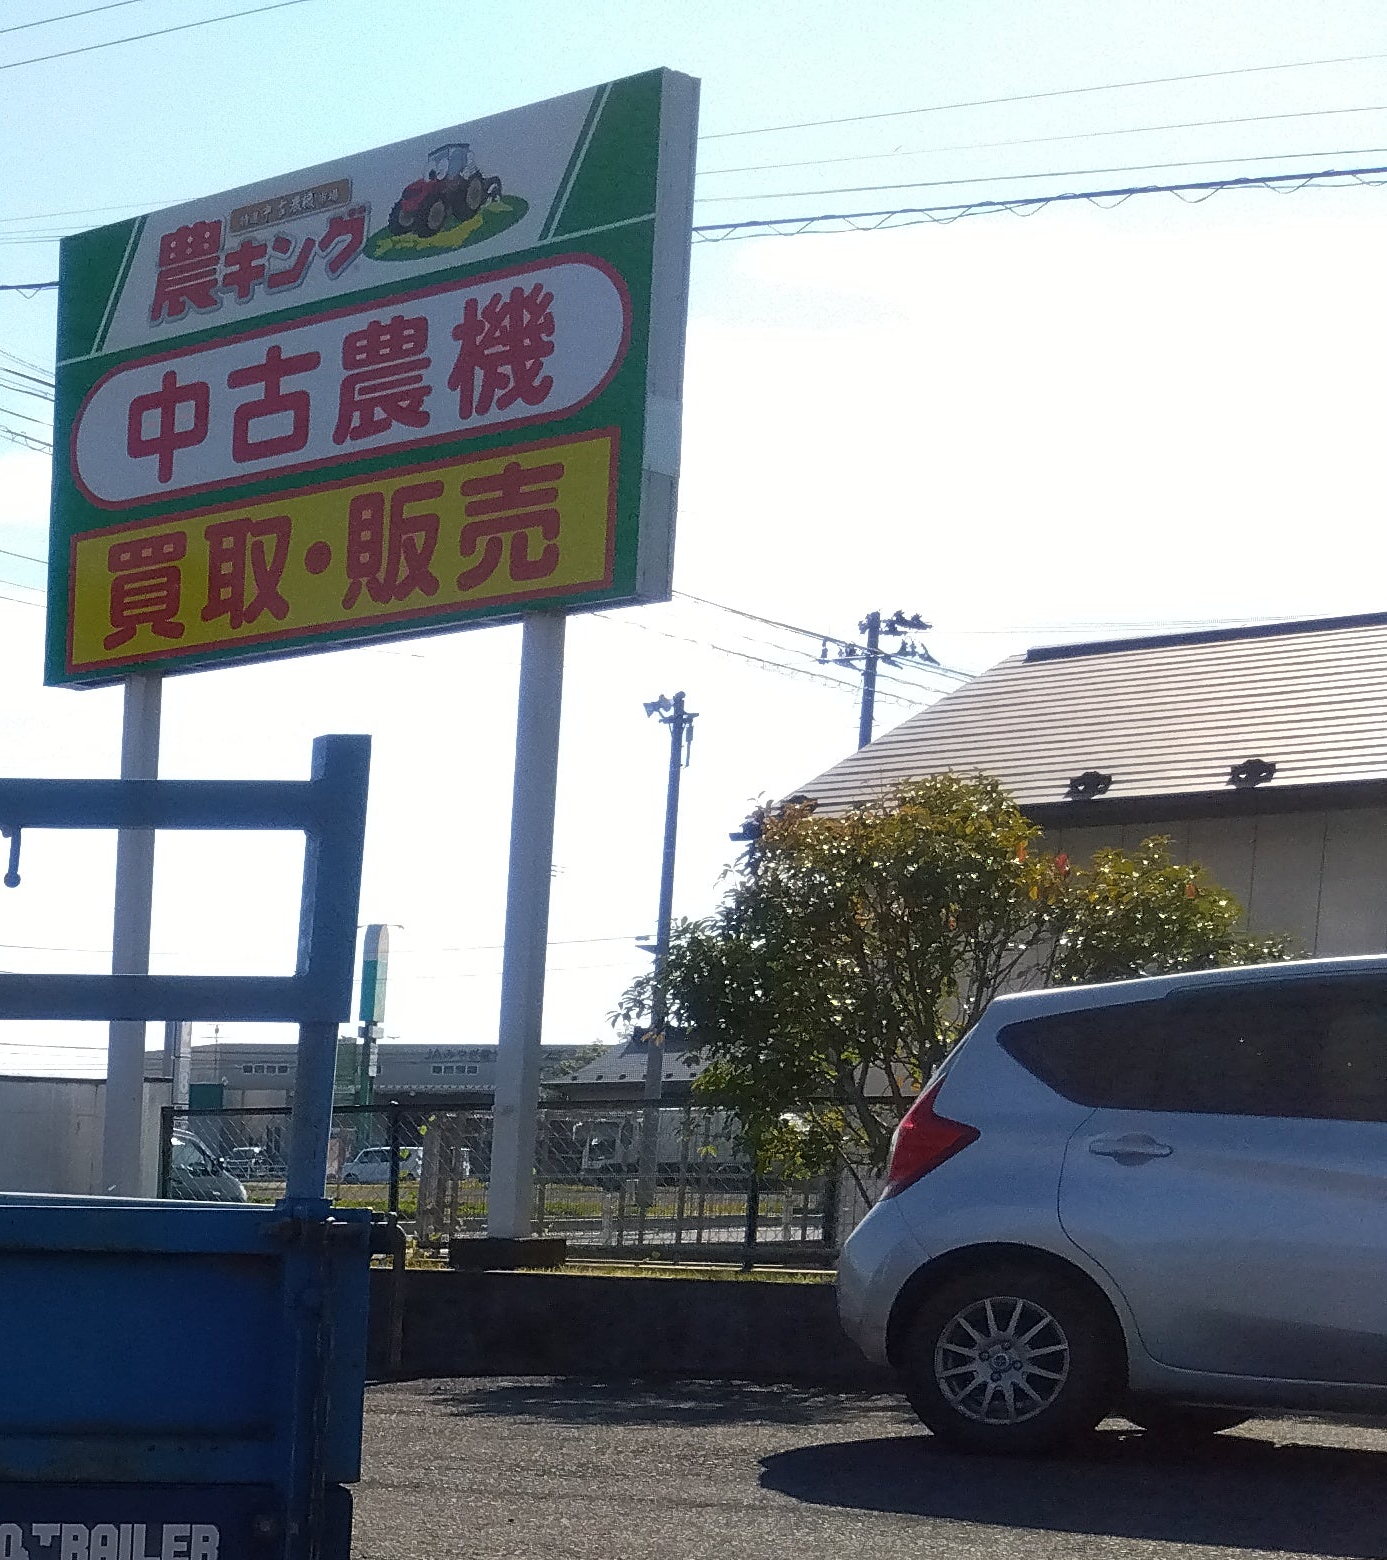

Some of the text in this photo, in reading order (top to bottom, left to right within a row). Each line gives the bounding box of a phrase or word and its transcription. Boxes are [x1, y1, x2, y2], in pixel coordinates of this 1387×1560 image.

[148, 206, 369, 325] 農キング
[126, 282, 556, 484] 中古農機
[102, 461, 565, 651] 買取・販売
